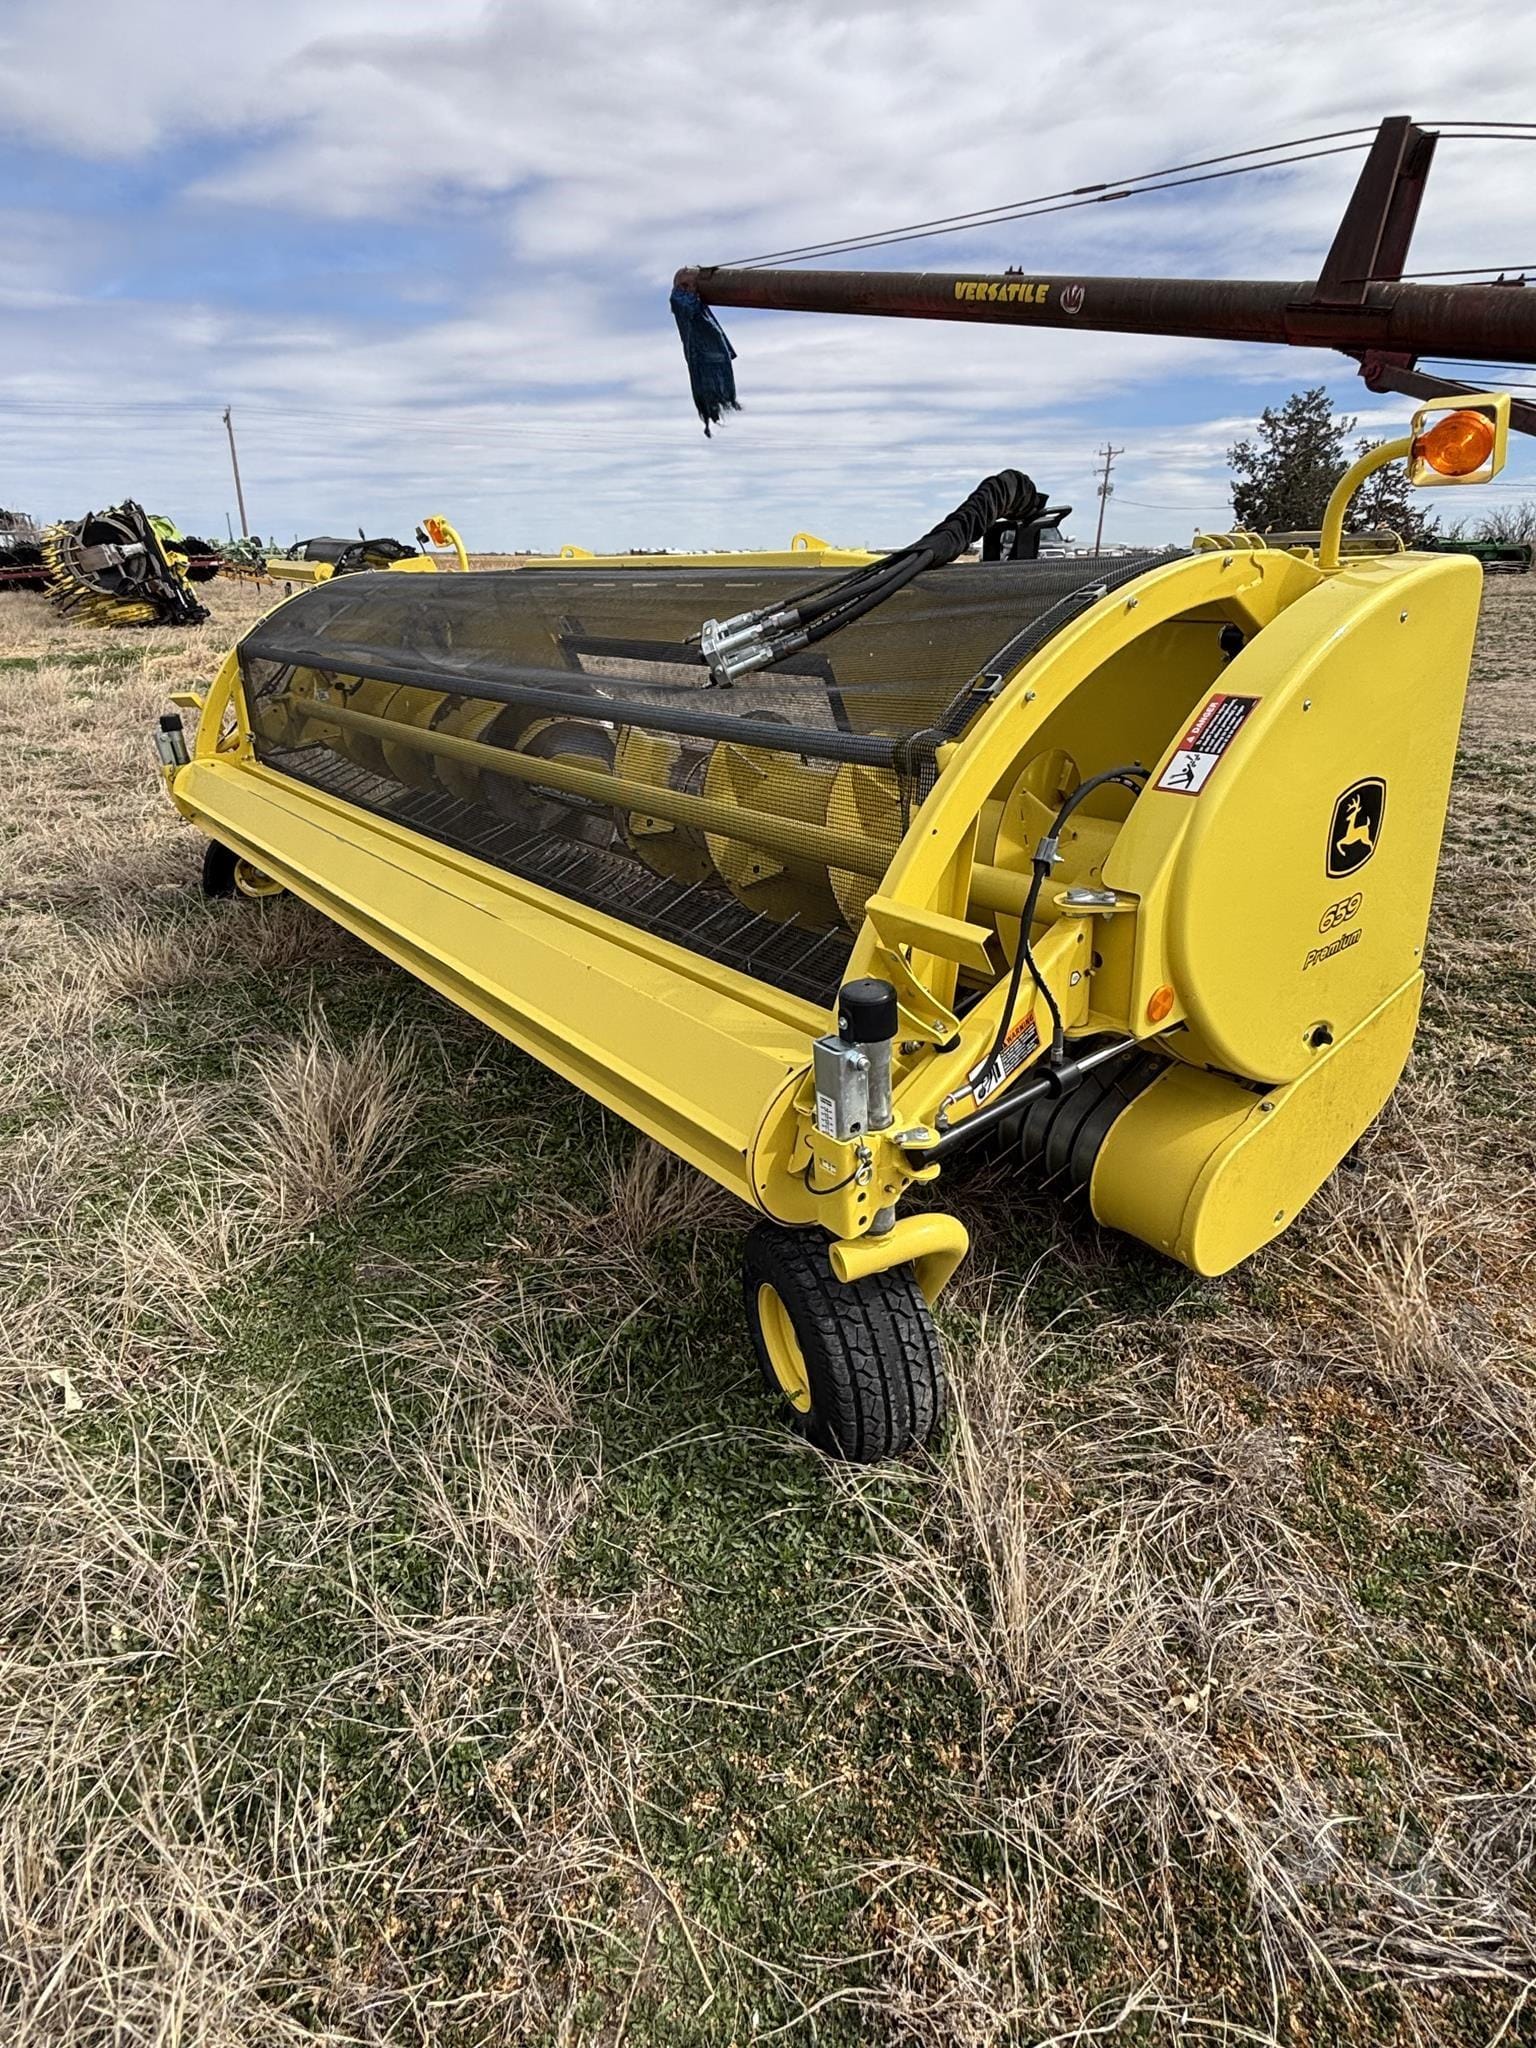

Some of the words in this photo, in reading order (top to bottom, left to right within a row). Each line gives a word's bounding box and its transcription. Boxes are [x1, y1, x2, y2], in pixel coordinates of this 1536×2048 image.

[954, 281, 1050, 303] VERSATILE
[1192, 702, 1219, 734] DANGER
[1318, 892, 1363, 934] 659
[1302, 928, 1362, 971] Premium
[1006, 1014, 1034, 1043] WARNING
